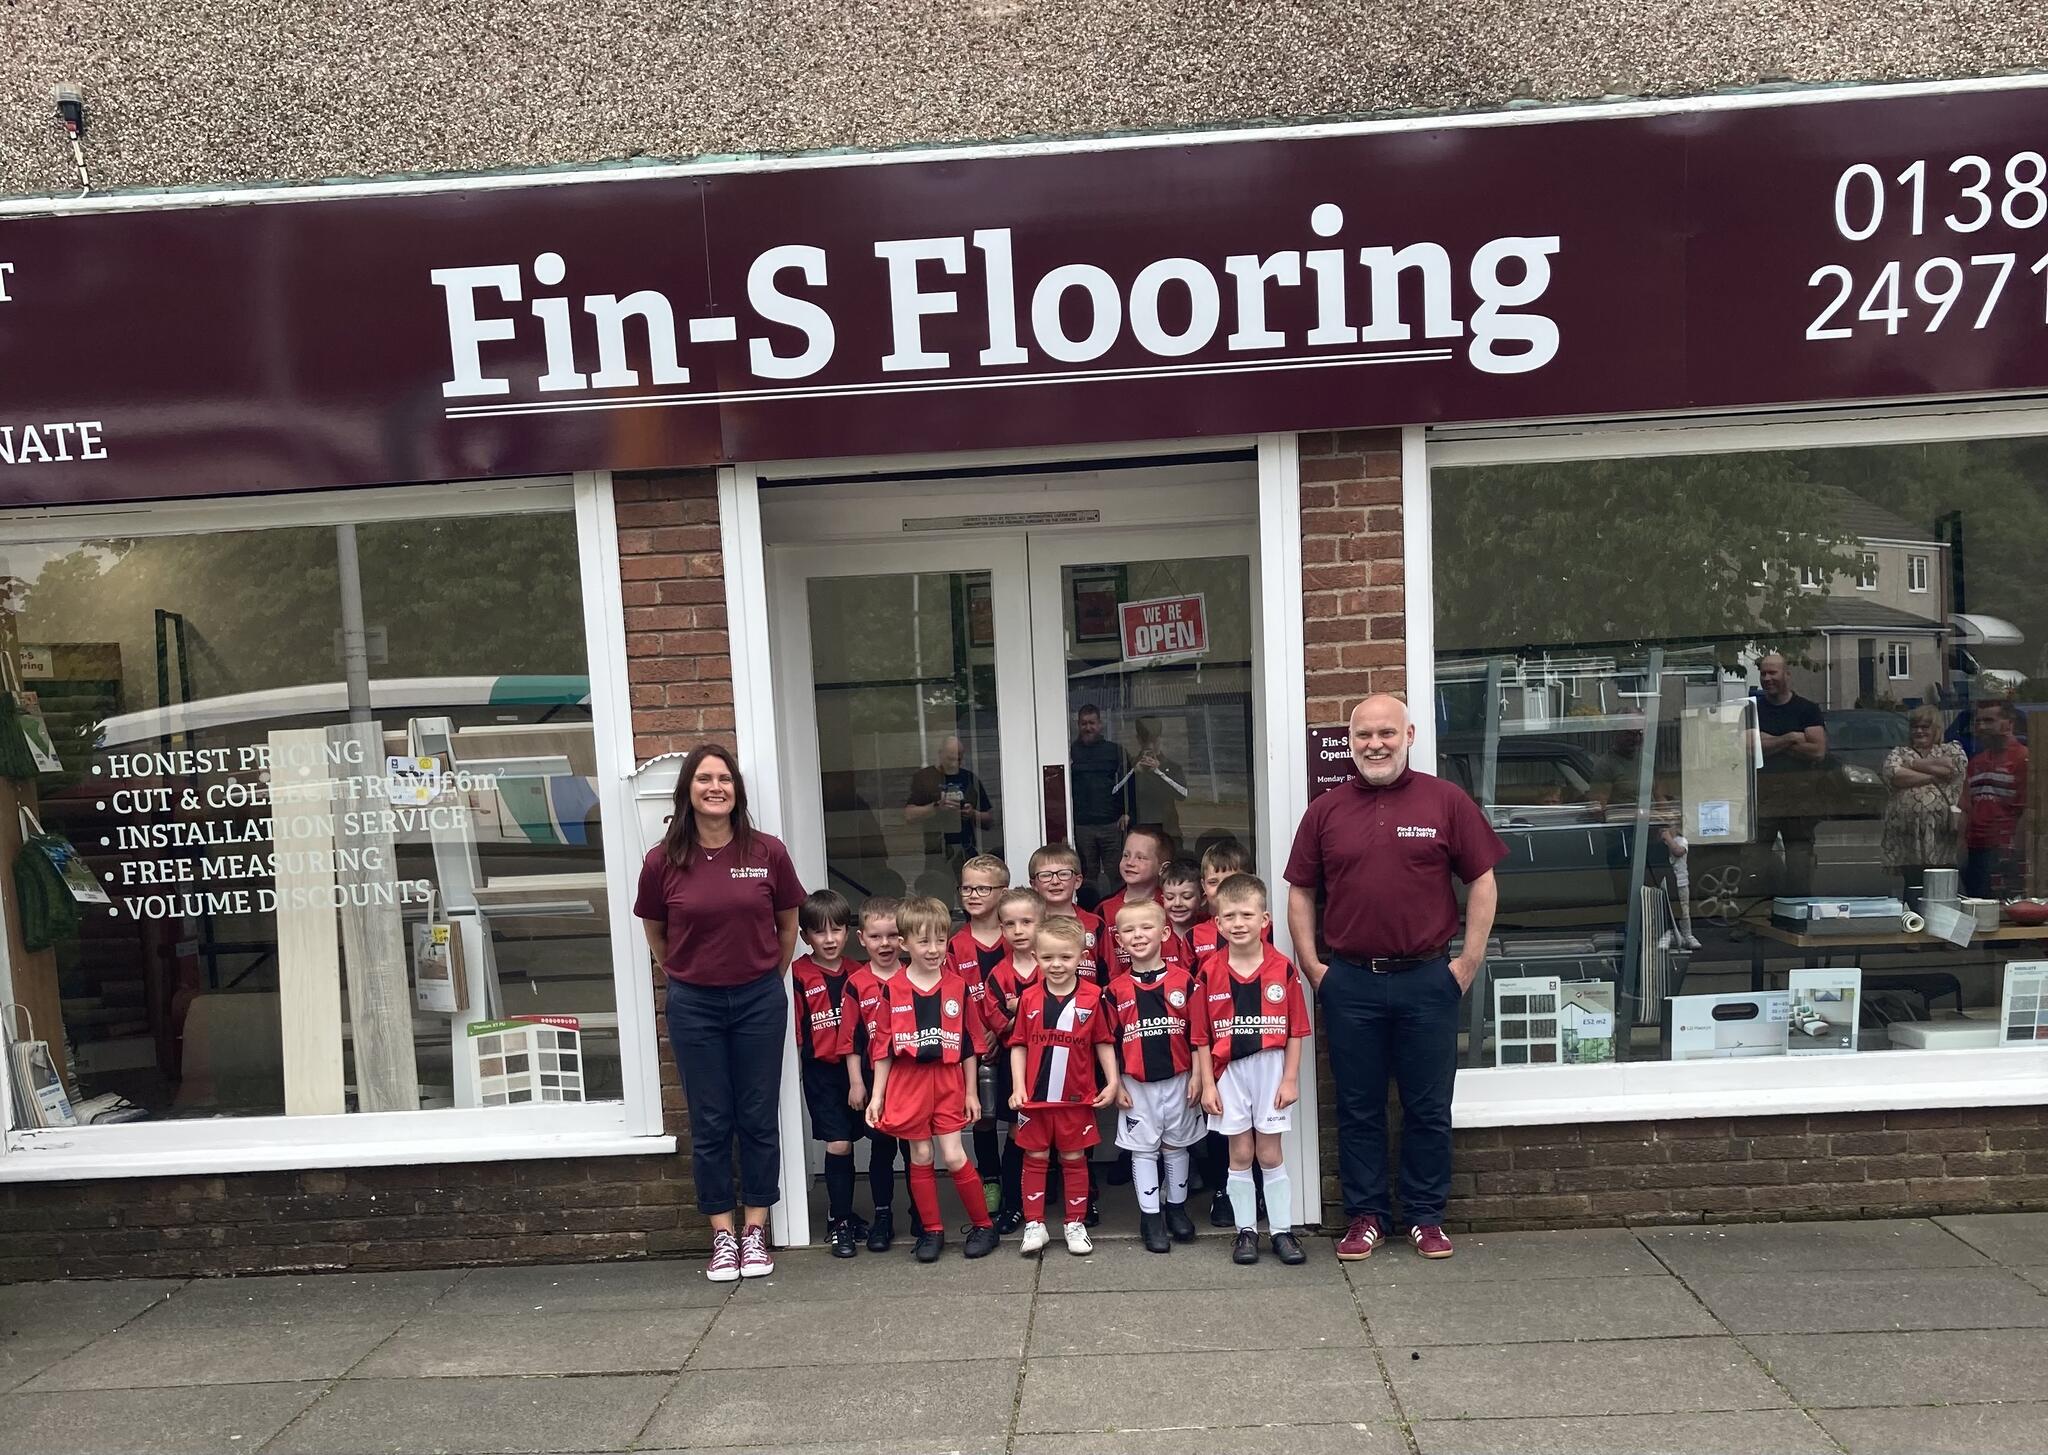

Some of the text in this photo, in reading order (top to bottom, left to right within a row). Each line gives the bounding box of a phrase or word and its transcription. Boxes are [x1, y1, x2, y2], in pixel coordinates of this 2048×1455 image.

[430, 203, 1561, 398] Fin-S Flooring
[1135, 620, 1196, 653] OPEN
[1321, 736, 1348, 747] Fin-S
[108, 740, 364, 779] HONEST PRICING
[112, 787, 172, 814] CUT
[180, 788, 201, 811] &
[207, 778, 339, 808] COLLECT
[347, 775, 436, 801] FROM
[116, 805, 468, 849] INSTALLATION SERVICE
[120, 847, 383, 885] FREE MEASURING
[124, 879, 432, 920] VOLUME DISCOUNTS
[811, 1009, 834, 1022] FIN-S
[1235, 1016, 1286, 1024] FLOORING
[895, 1031, 919, 1041] FIN-S
[921, 1039, 939, 1047] ROAD
